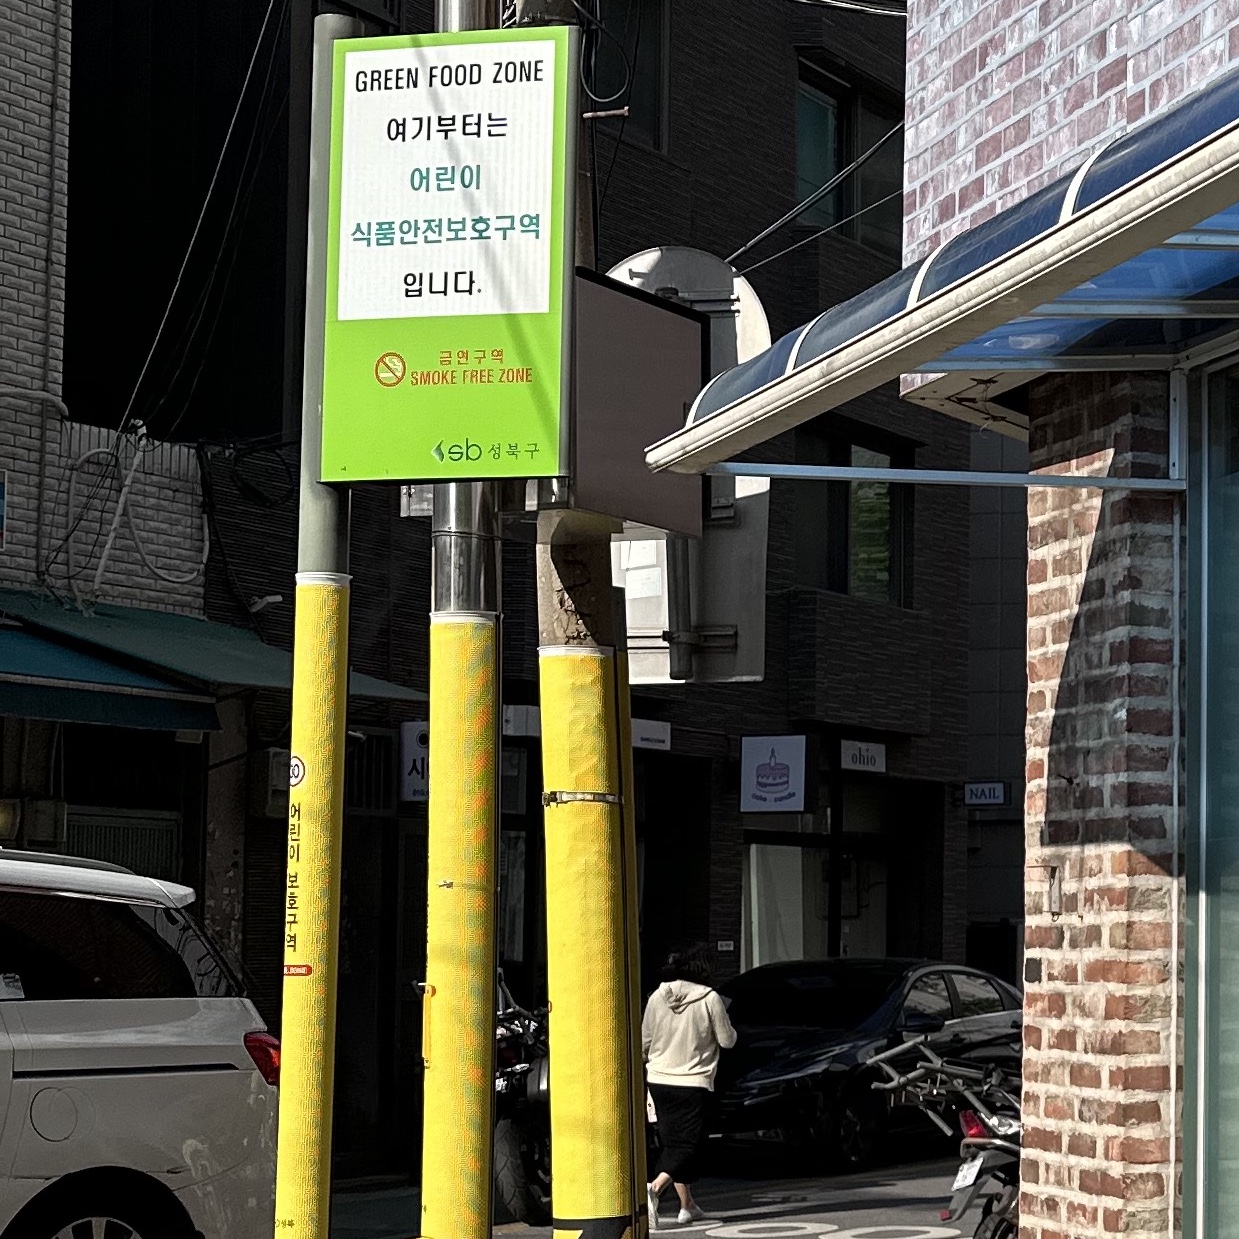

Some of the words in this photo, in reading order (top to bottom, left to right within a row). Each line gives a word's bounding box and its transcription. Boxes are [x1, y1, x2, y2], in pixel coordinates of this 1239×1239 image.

[355, 66, 419, 92] GREEN
[428, 63, 482, 88] FOOD
[492, 59, 544, 84] ZONE
[386, 112, 508, 142] 여기부터는
[410, 164, 481, 193] 어린이
[350, 213, 540, 248] 식품안전보호구역
[403, 270, 482, 298] 입니다.
[439, 348, 504, 366] 금연구역
[410, 369, 457, 386] SMOKE
[462, 368, 494, 385] FREE
[497, 367, 533, 384] ZONE
[447, 437, 483, 462] sb
[488, 442, 540, 461] 성북구
[407, 756, 429, 780] 시
[851, 747, 877, 767] ohio
[968, 786, 1000, 801] NAIL
